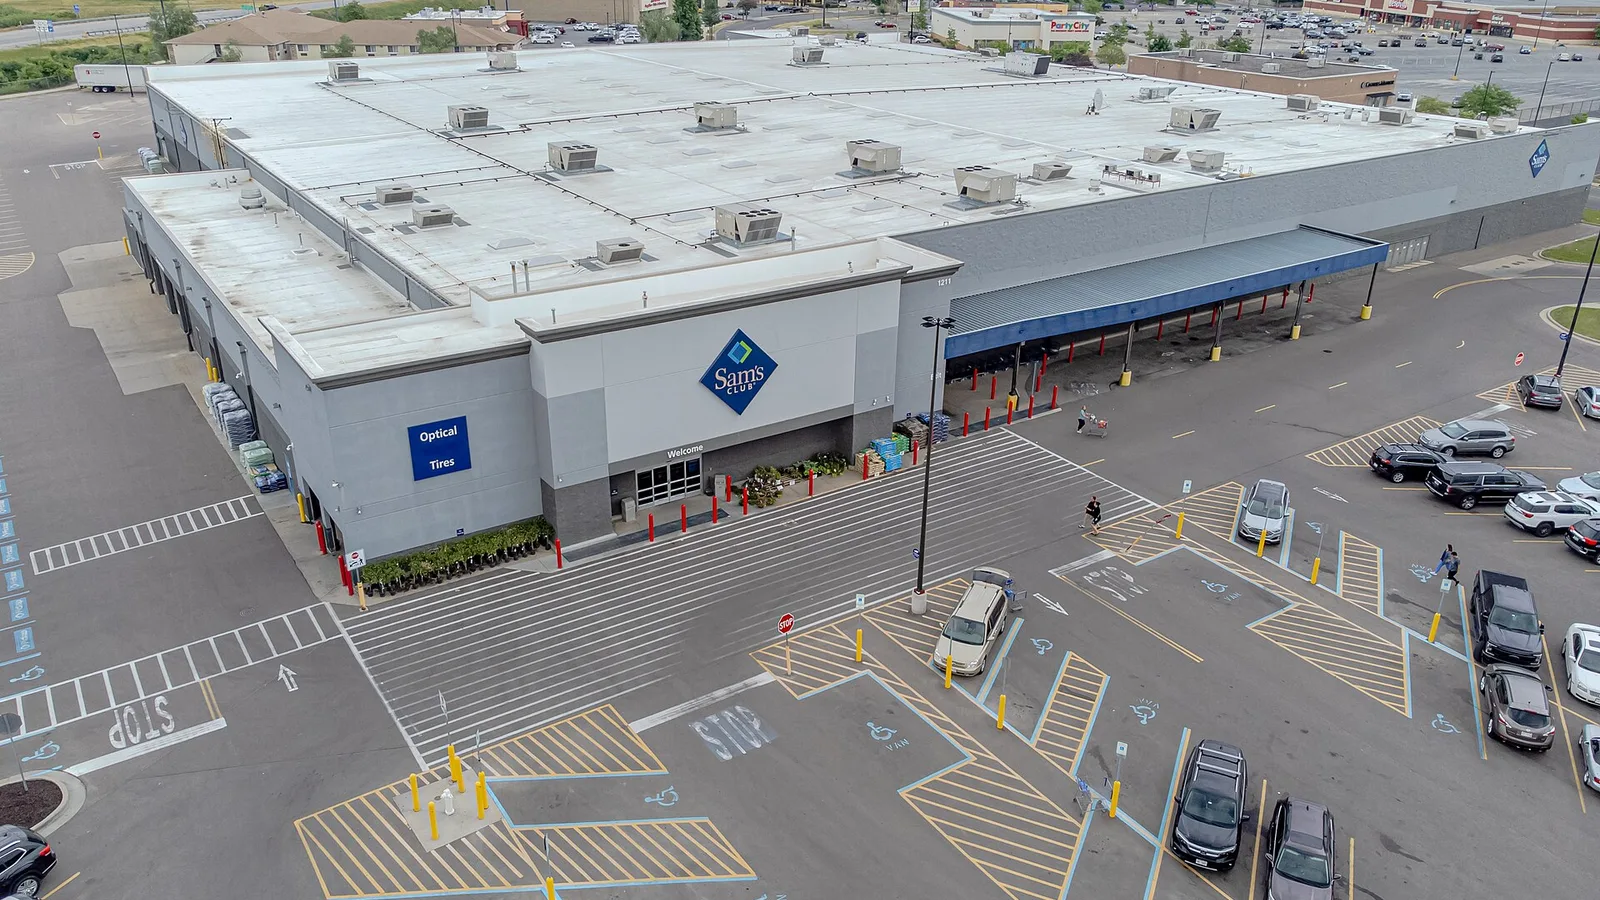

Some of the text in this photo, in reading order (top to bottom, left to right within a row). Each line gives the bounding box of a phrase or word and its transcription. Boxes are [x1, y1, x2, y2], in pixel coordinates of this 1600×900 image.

[1051, 21, 1090, 30] Party City
[938, 278, 951, 286] 1211
[715, 365, 764, 390] Sam's
[420, 425, 458, 443] Optical
[667, 444, 704, 459] Welcome
[429, 458, 455, 470] Tires
[779, 617, 793, 630] STOP
[109, 695, 175, 749] STOP
[689, 705, 771, 761] STOP
[885, 738, 910, 752] VAN
